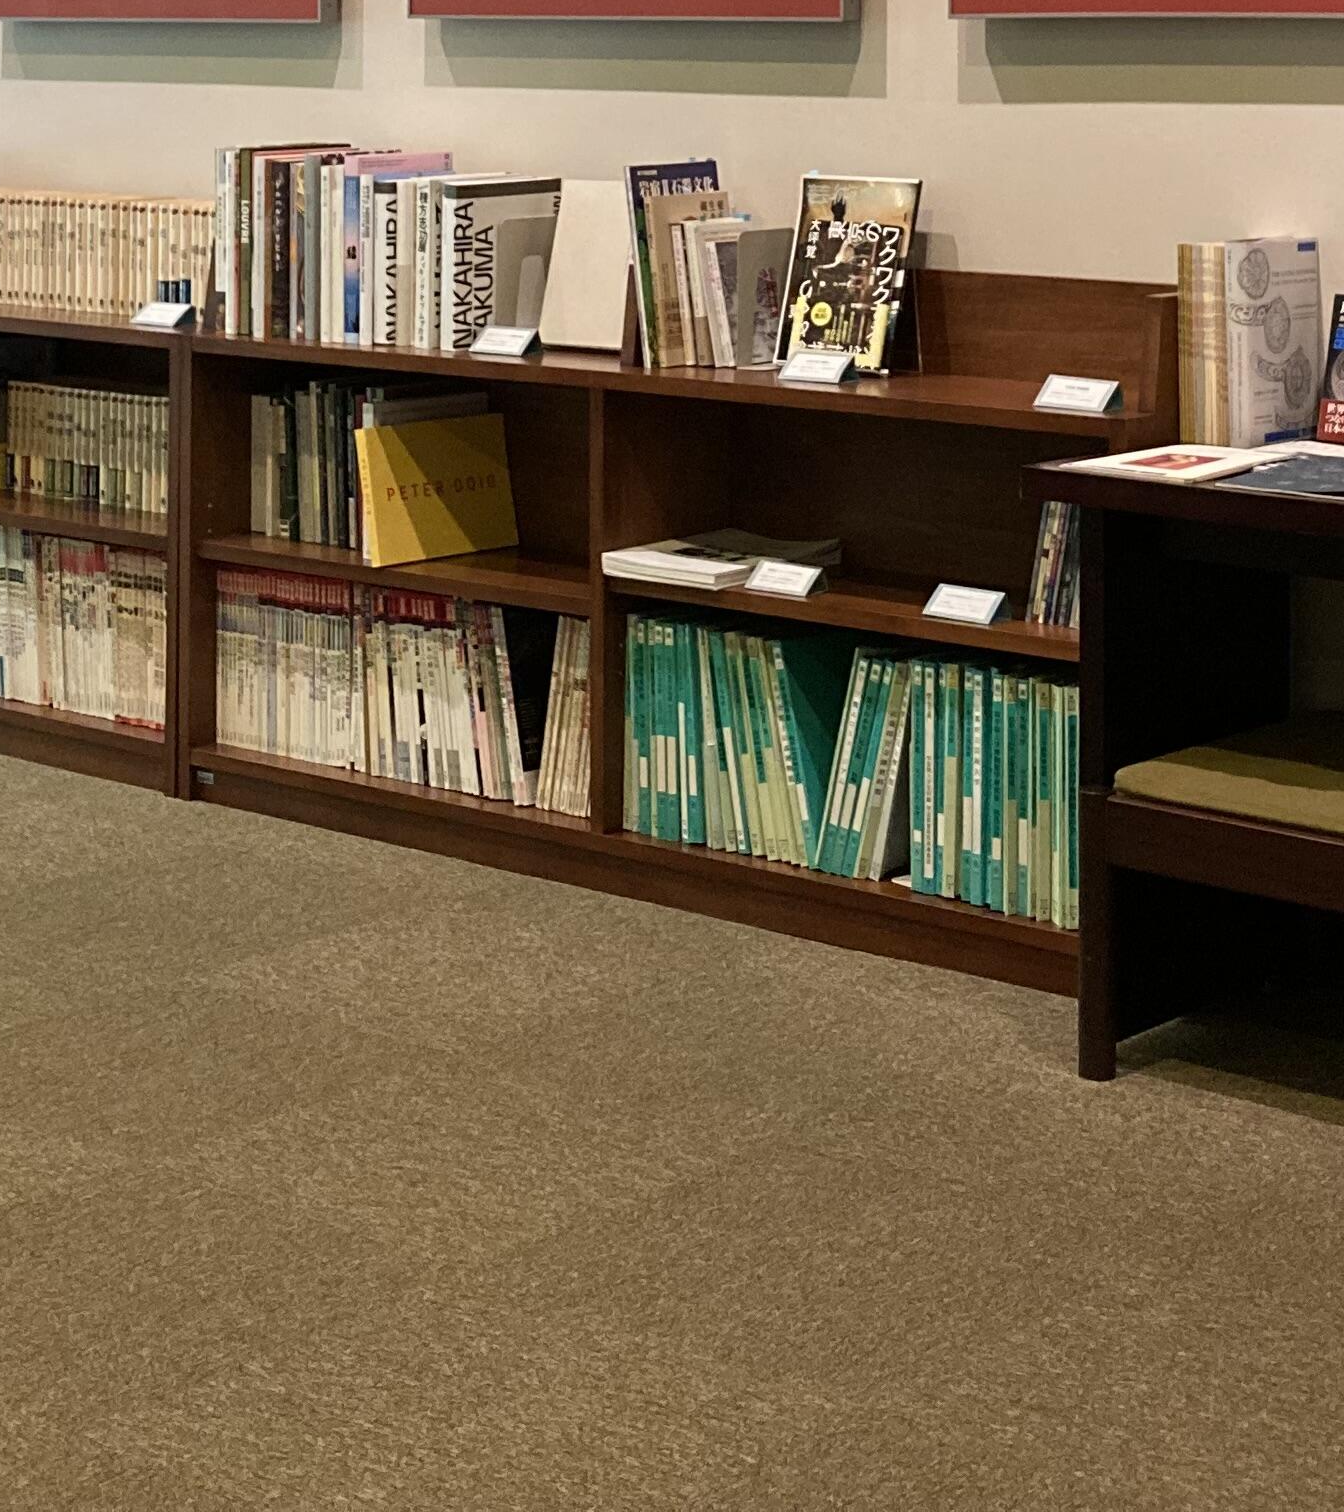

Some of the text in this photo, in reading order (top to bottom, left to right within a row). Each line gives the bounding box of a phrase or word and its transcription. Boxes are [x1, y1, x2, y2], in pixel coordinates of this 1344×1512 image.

[241, 200, 250, 243] LOUVRE
[453, 201, 474, 349] NAKAHIRA
[386, 473, 496, 502] PETER DOIG
